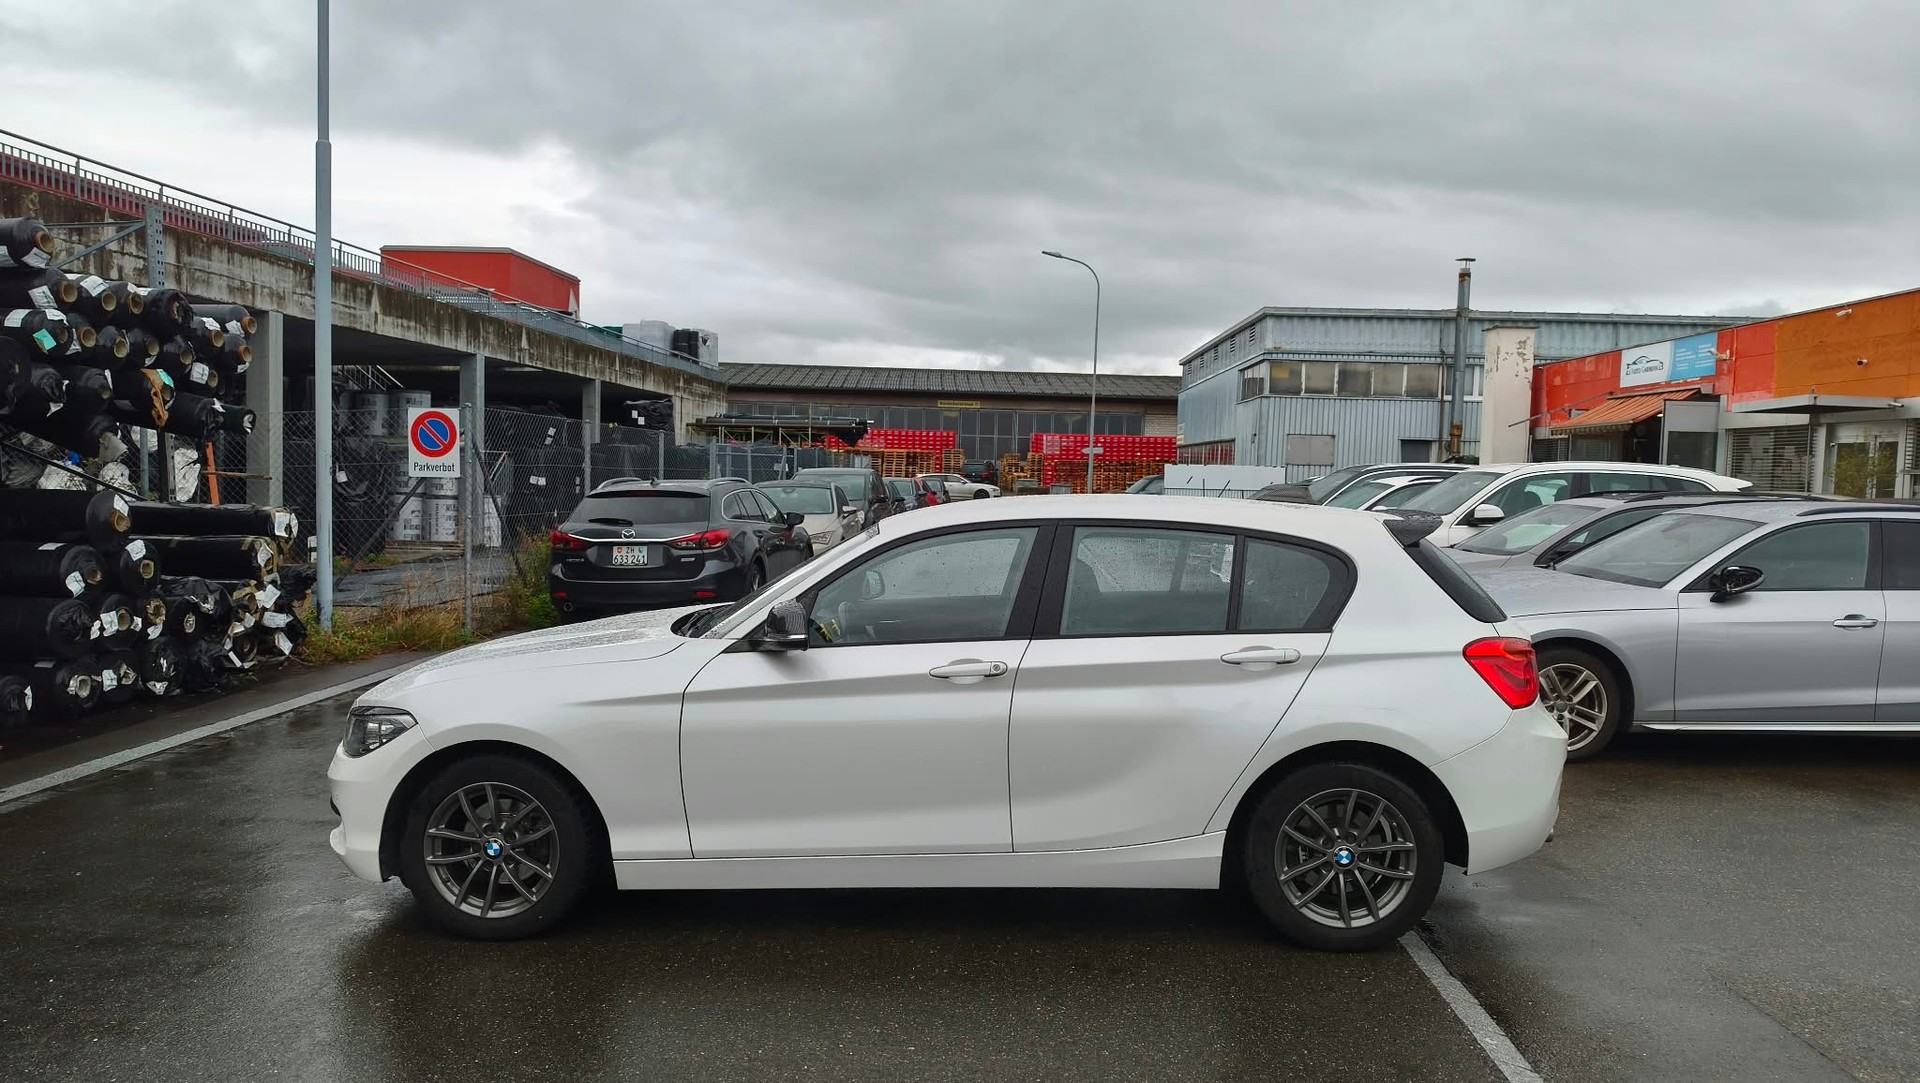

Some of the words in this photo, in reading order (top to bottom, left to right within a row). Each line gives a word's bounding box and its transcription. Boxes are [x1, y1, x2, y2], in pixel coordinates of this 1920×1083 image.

[413, 462, 455, 472] Parkverbot
[613, 555, 629, 564] 633
[631, 555, 646, 564] 241
